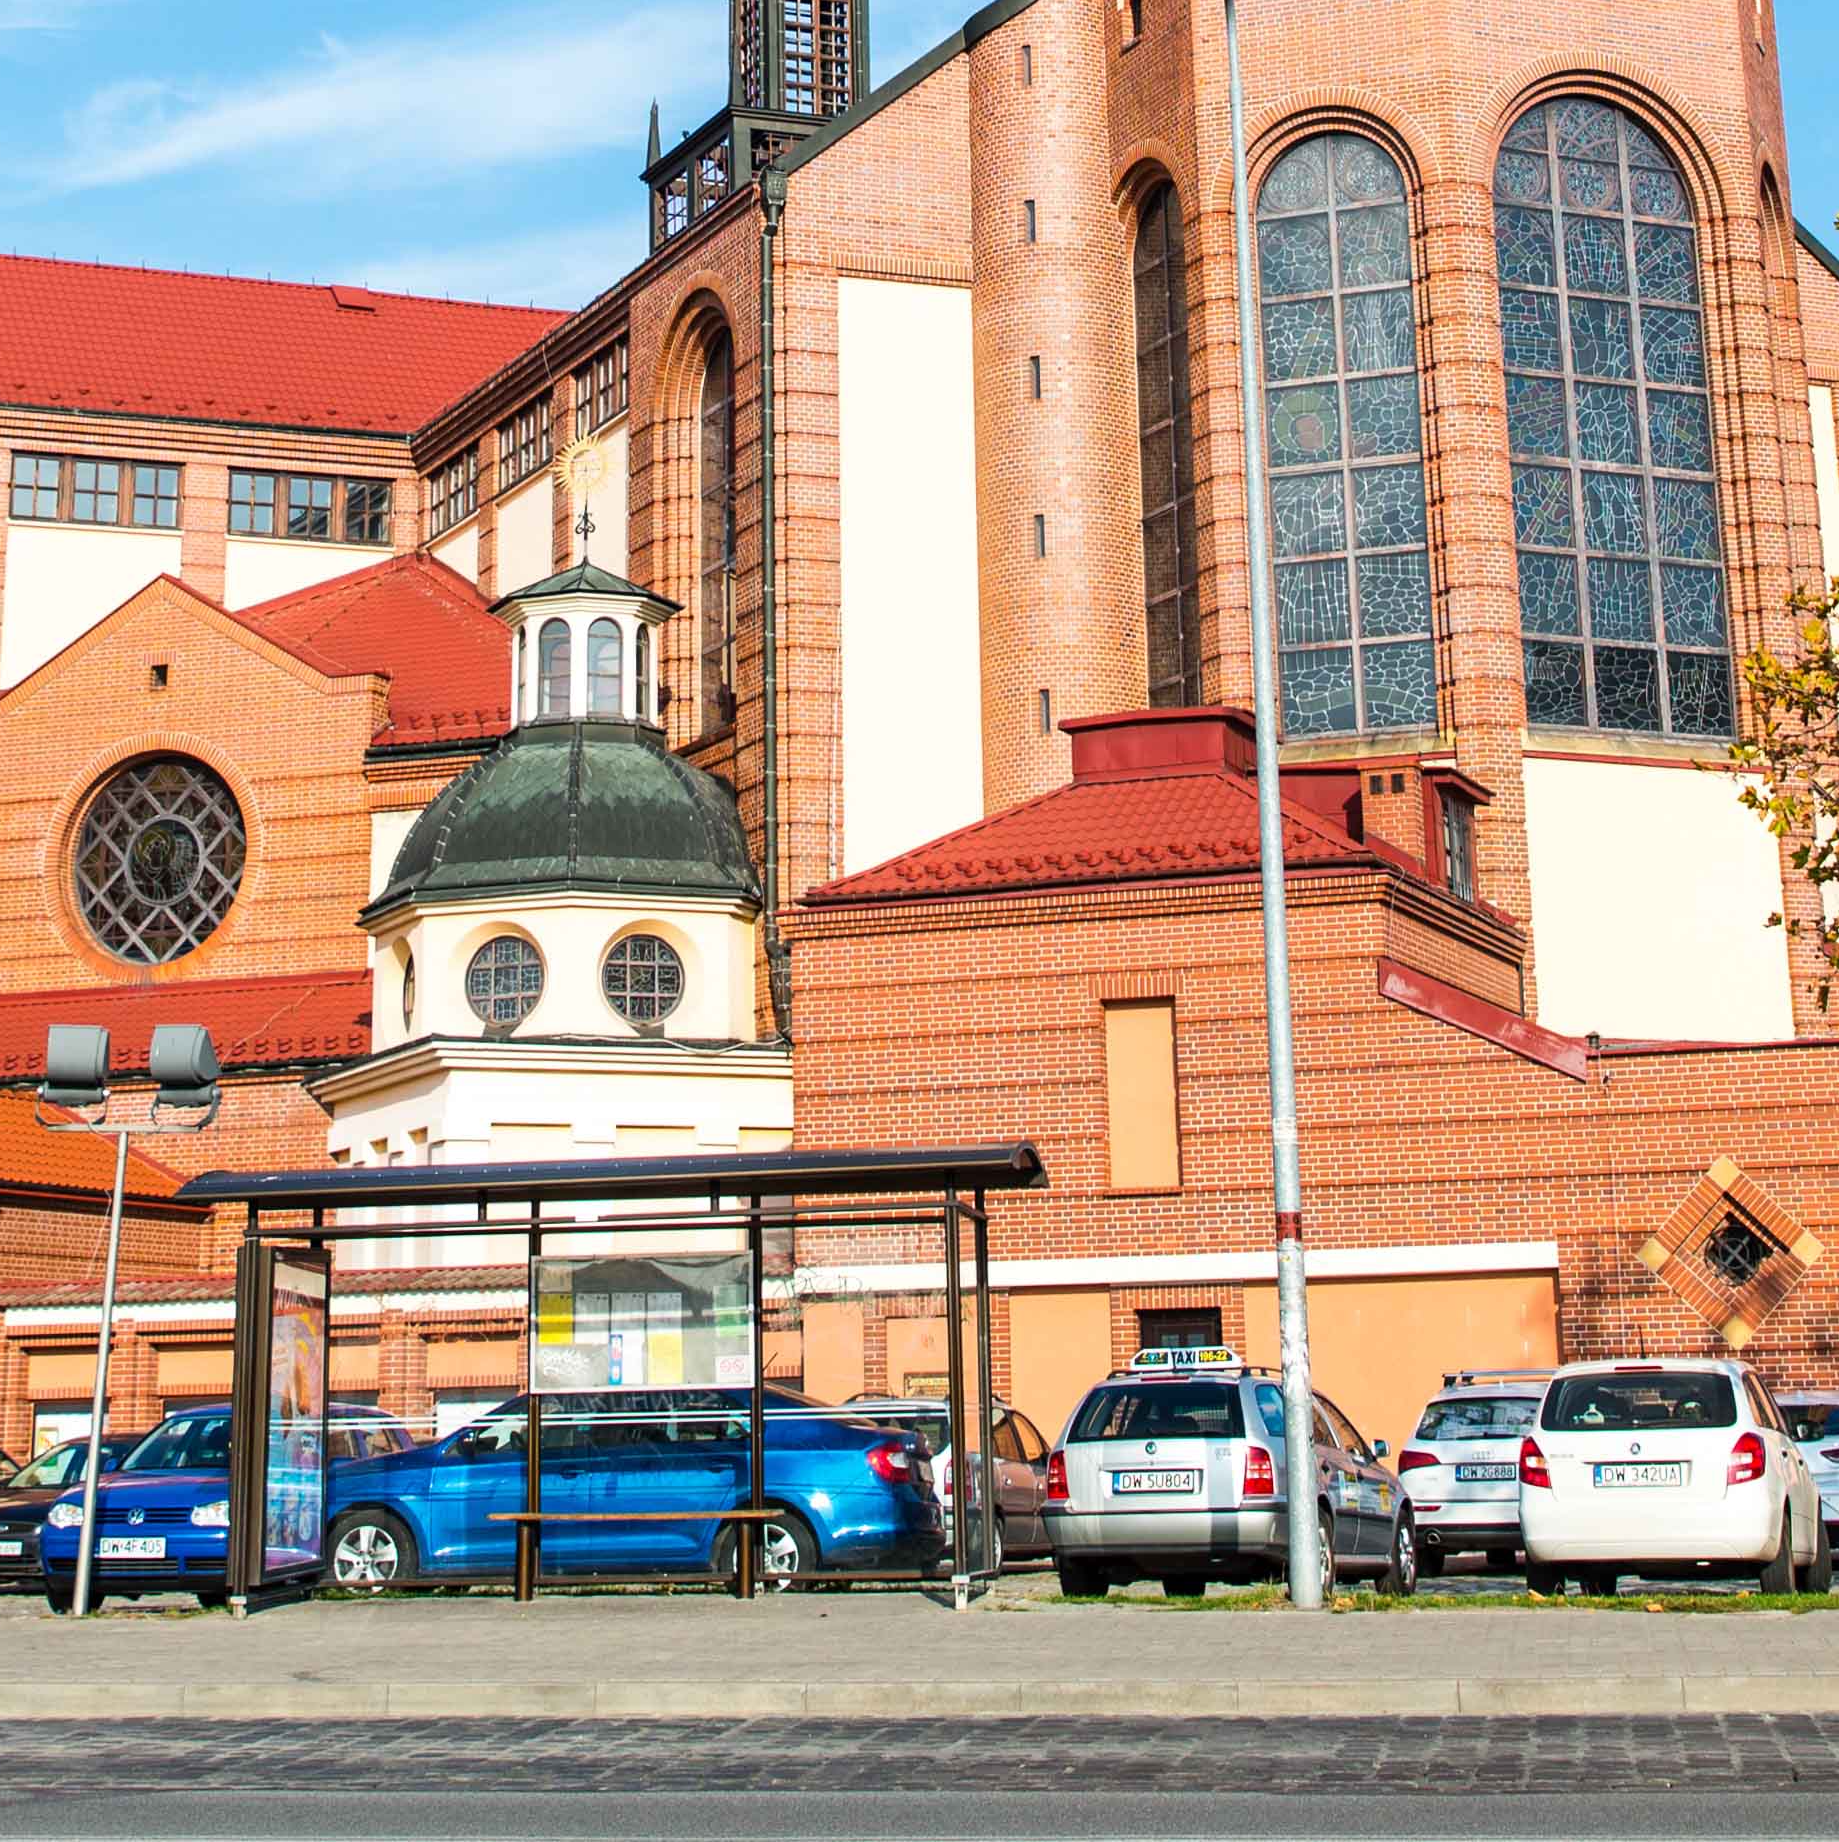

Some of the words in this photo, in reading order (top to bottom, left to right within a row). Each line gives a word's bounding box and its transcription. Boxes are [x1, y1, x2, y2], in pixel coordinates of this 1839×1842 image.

[1171, 1350, 1196, 1365] TAXI
[1462, 1464, 1478, 1478] DW
[1603, 1469, 1626, 1483] DW
[1632, 1468, 1678, 1483] 342UA
[1122, 1474, 1142, 1490] DW
[1148, 1473, 1191, 1489] 5U804
[102, 1539, 120, 1554] DW
